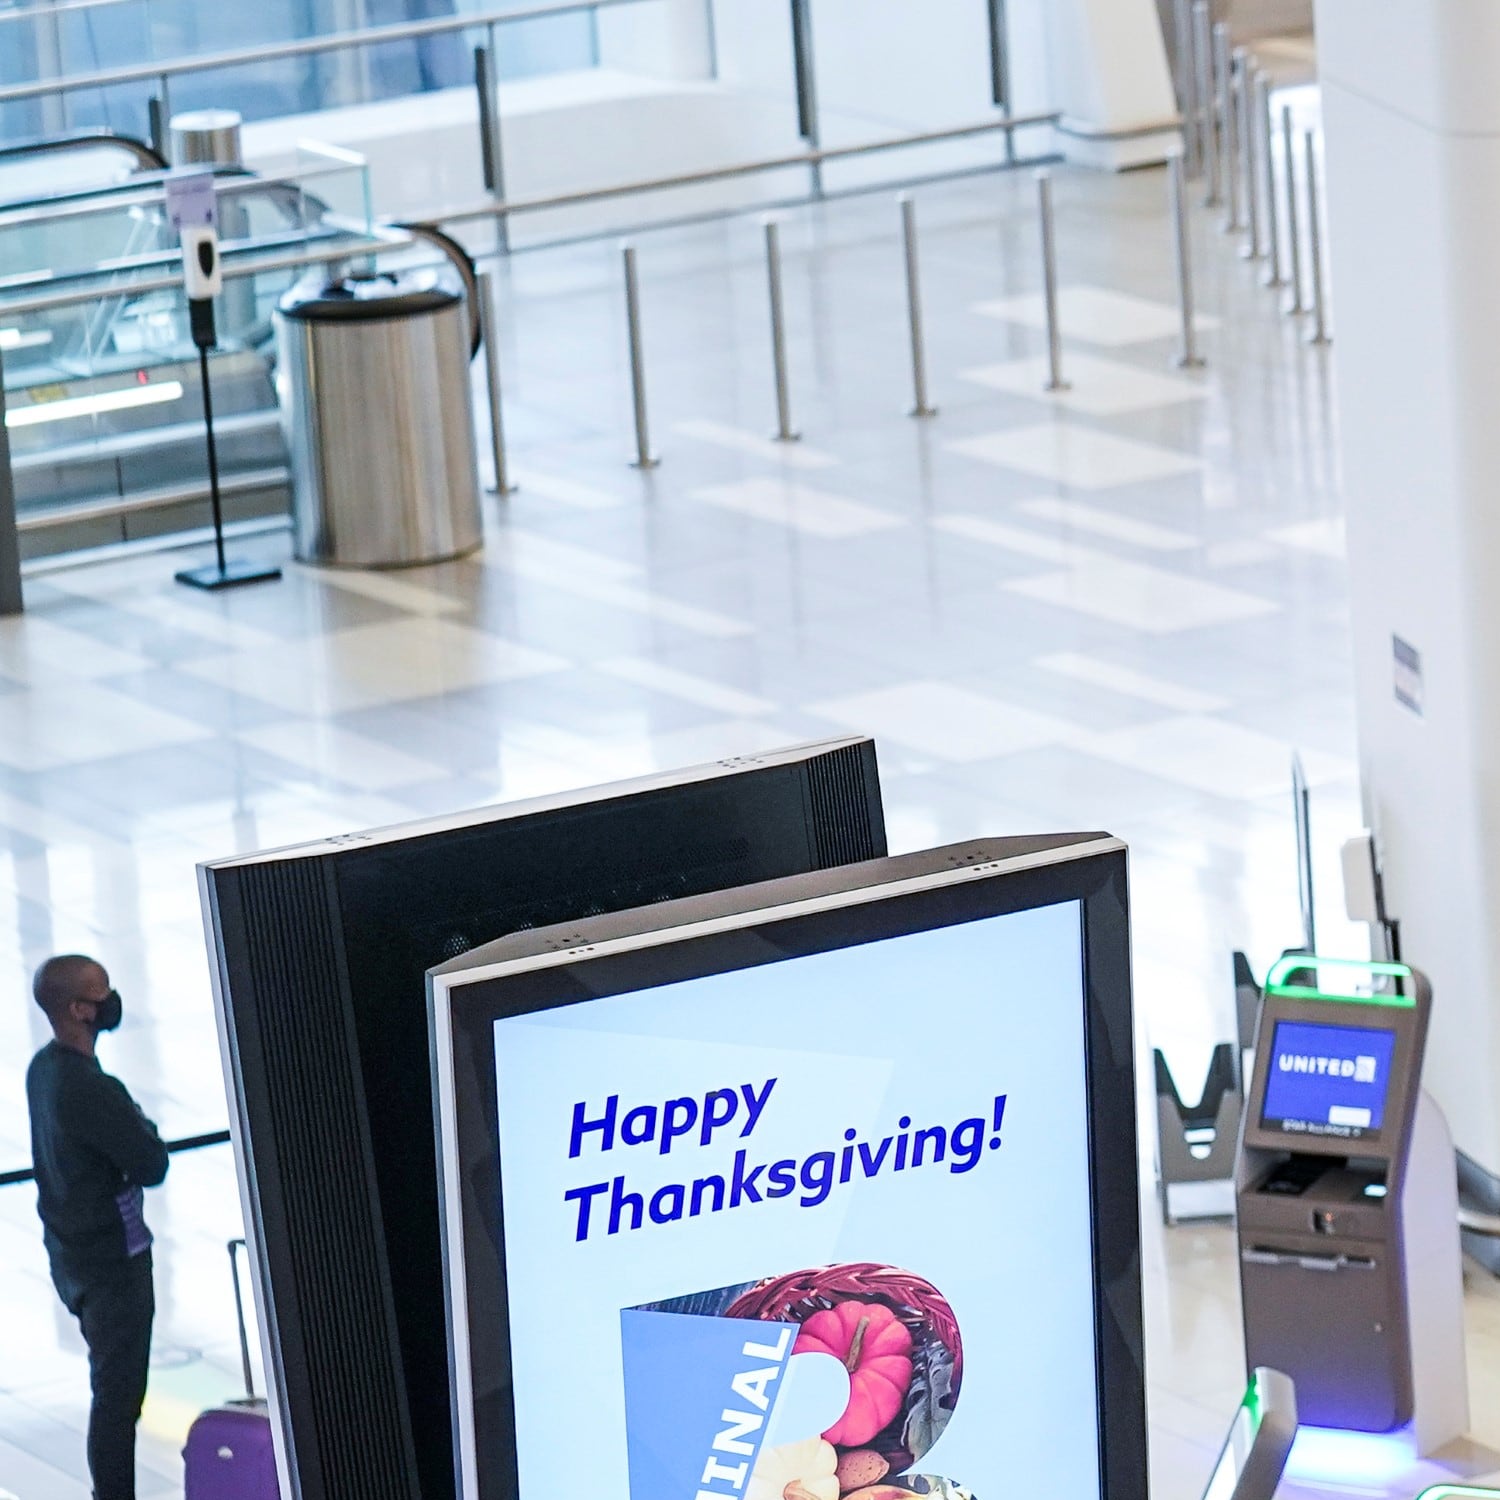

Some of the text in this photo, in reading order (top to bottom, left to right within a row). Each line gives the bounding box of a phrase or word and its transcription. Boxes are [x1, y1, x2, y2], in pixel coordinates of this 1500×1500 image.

[1279, 1053, 1356, 1077] UNITED
[568, 1077, 778, 1159] Happy
[564, 1094, 1008, 1243] Thanksgiving!
